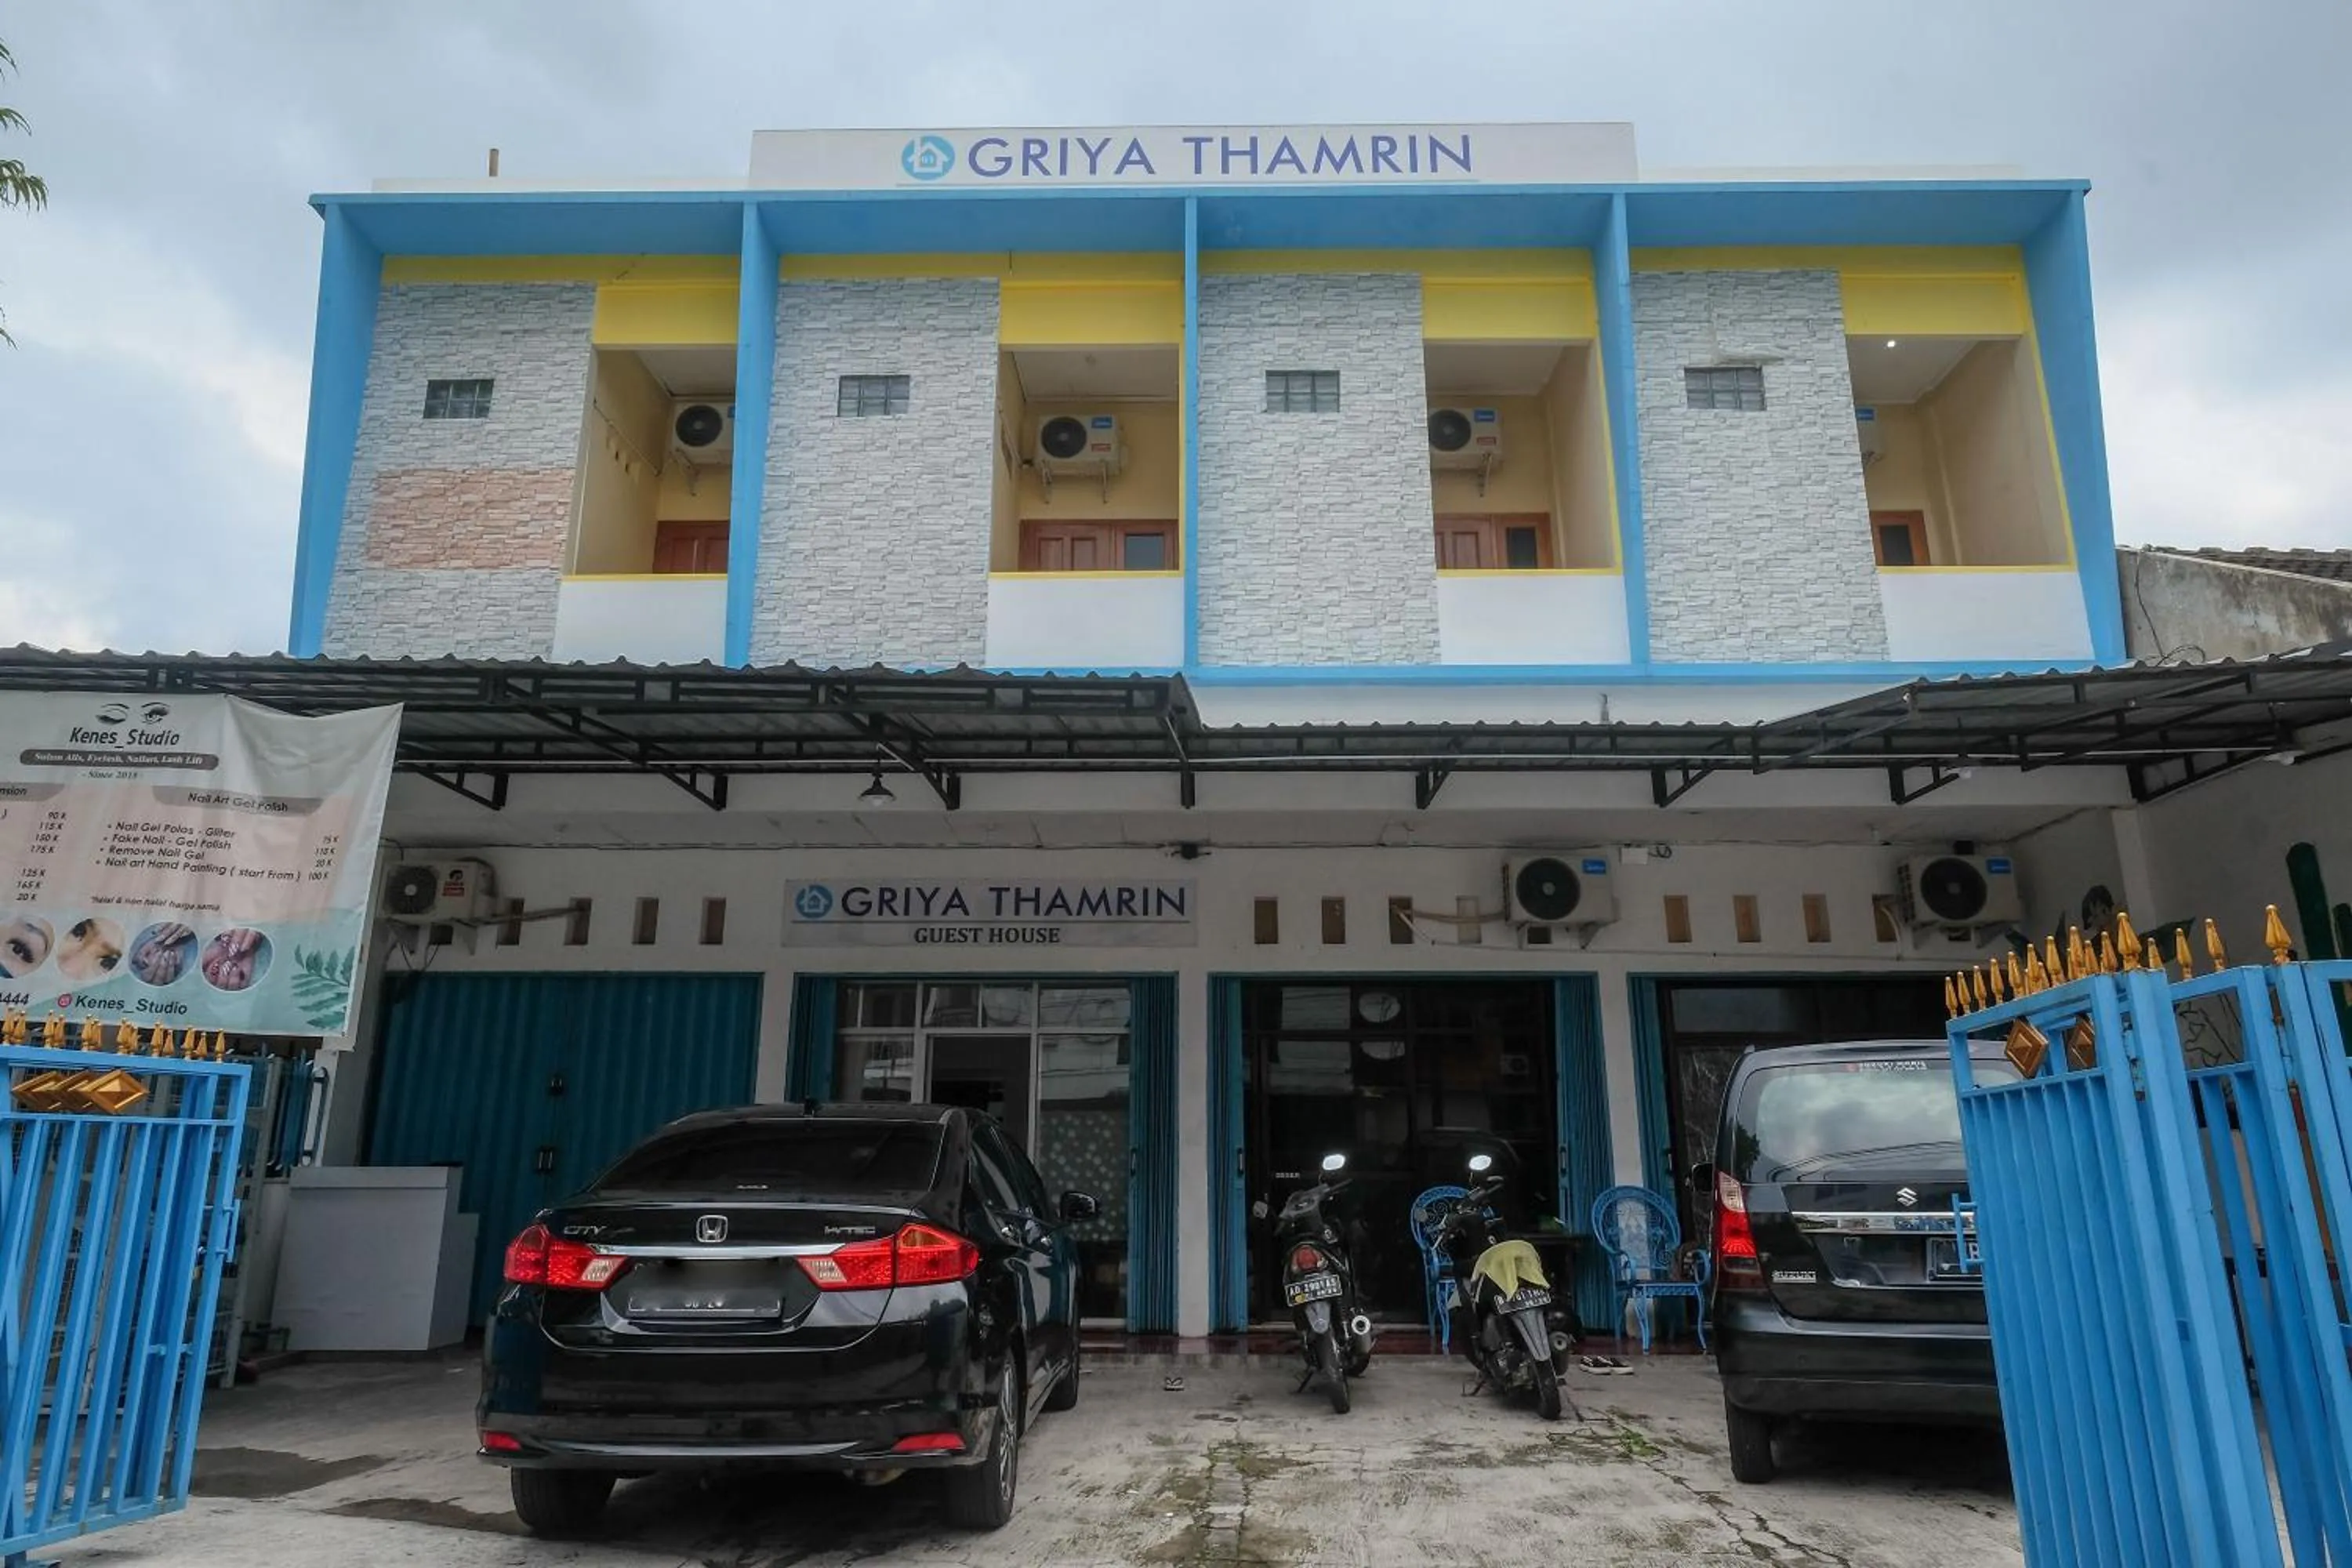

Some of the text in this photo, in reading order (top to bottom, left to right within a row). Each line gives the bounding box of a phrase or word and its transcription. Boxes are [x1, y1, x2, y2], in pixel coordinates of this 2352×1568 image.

[967, 134, 1473, 178] GRIYA THAMRIN
[69, 727, 180, 749] Kenes_Studio
[188, 793, 212, 803] Nail
[212, 794, 230, 804] Art
[232, 797, 255, 808] Gel
[140, 822, 160, 832] Gel
[142, 836, 165, 844] Nail
[175, 837, 198, 847] Gel
[109, 845, 205, 860] Remove Nail Gel
[105, 858, 127, 866] Nail
[147, 861, 179, 869] Hand
[183, 862, 227, 876] Painting
[841, 886, 1185, 916] GRIYA THAMRIN
[913, 927, 1061, 943] GUEST HOUSE
[75, 995, 188, 1015] Kenes_Studio
